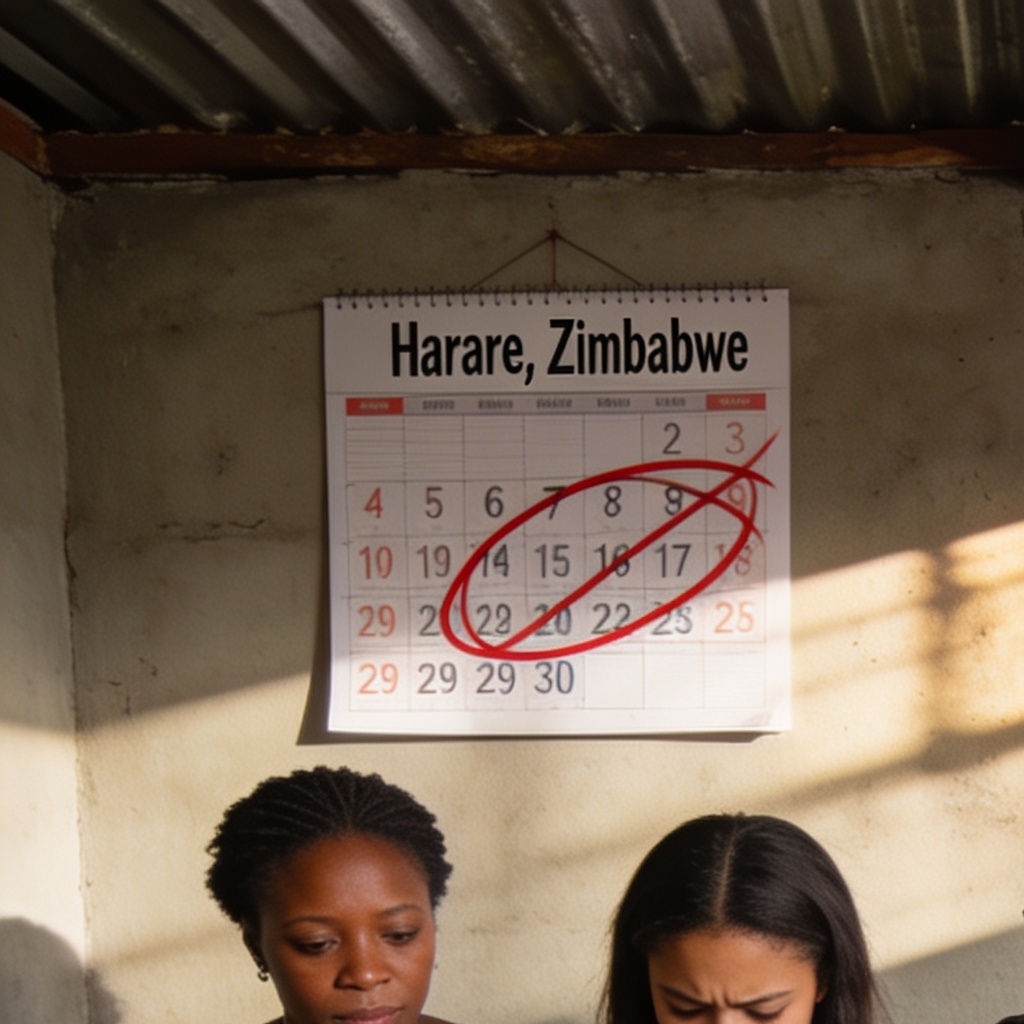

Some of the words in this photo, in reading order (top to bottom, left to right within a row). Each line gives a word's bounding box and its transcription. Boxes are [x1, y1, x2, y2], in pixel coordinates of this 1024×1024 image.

[391, 321, 534, 386] Harare,
[547, 317, 748, 375] Zimbabwe
[662, 422, 682, 455] 2
[725, 421, 745, 454] 3
[364, 486, 383, 519] 4
[425, 486, 443, 519] 5
[484, 486, 504, 518] 6
[542, 485, 567, 520] 7
[604, 485, 622, 517] 8
[359, 545, 393, 579] 10
[416, 544, 451, 579] 19
[535, 544, 570, 578] 15
[655, 543, 692, 578] 17
[357, 604, 396, 637] 29
[591, 603, 631, 634] 22
[714, 601, 755, 634] 25
[357, 662, 399, 694] 29
[417, 662, 458, 694] 29
[476, 662, 516, 695] 29
[534, 660, 575, 694] 30
